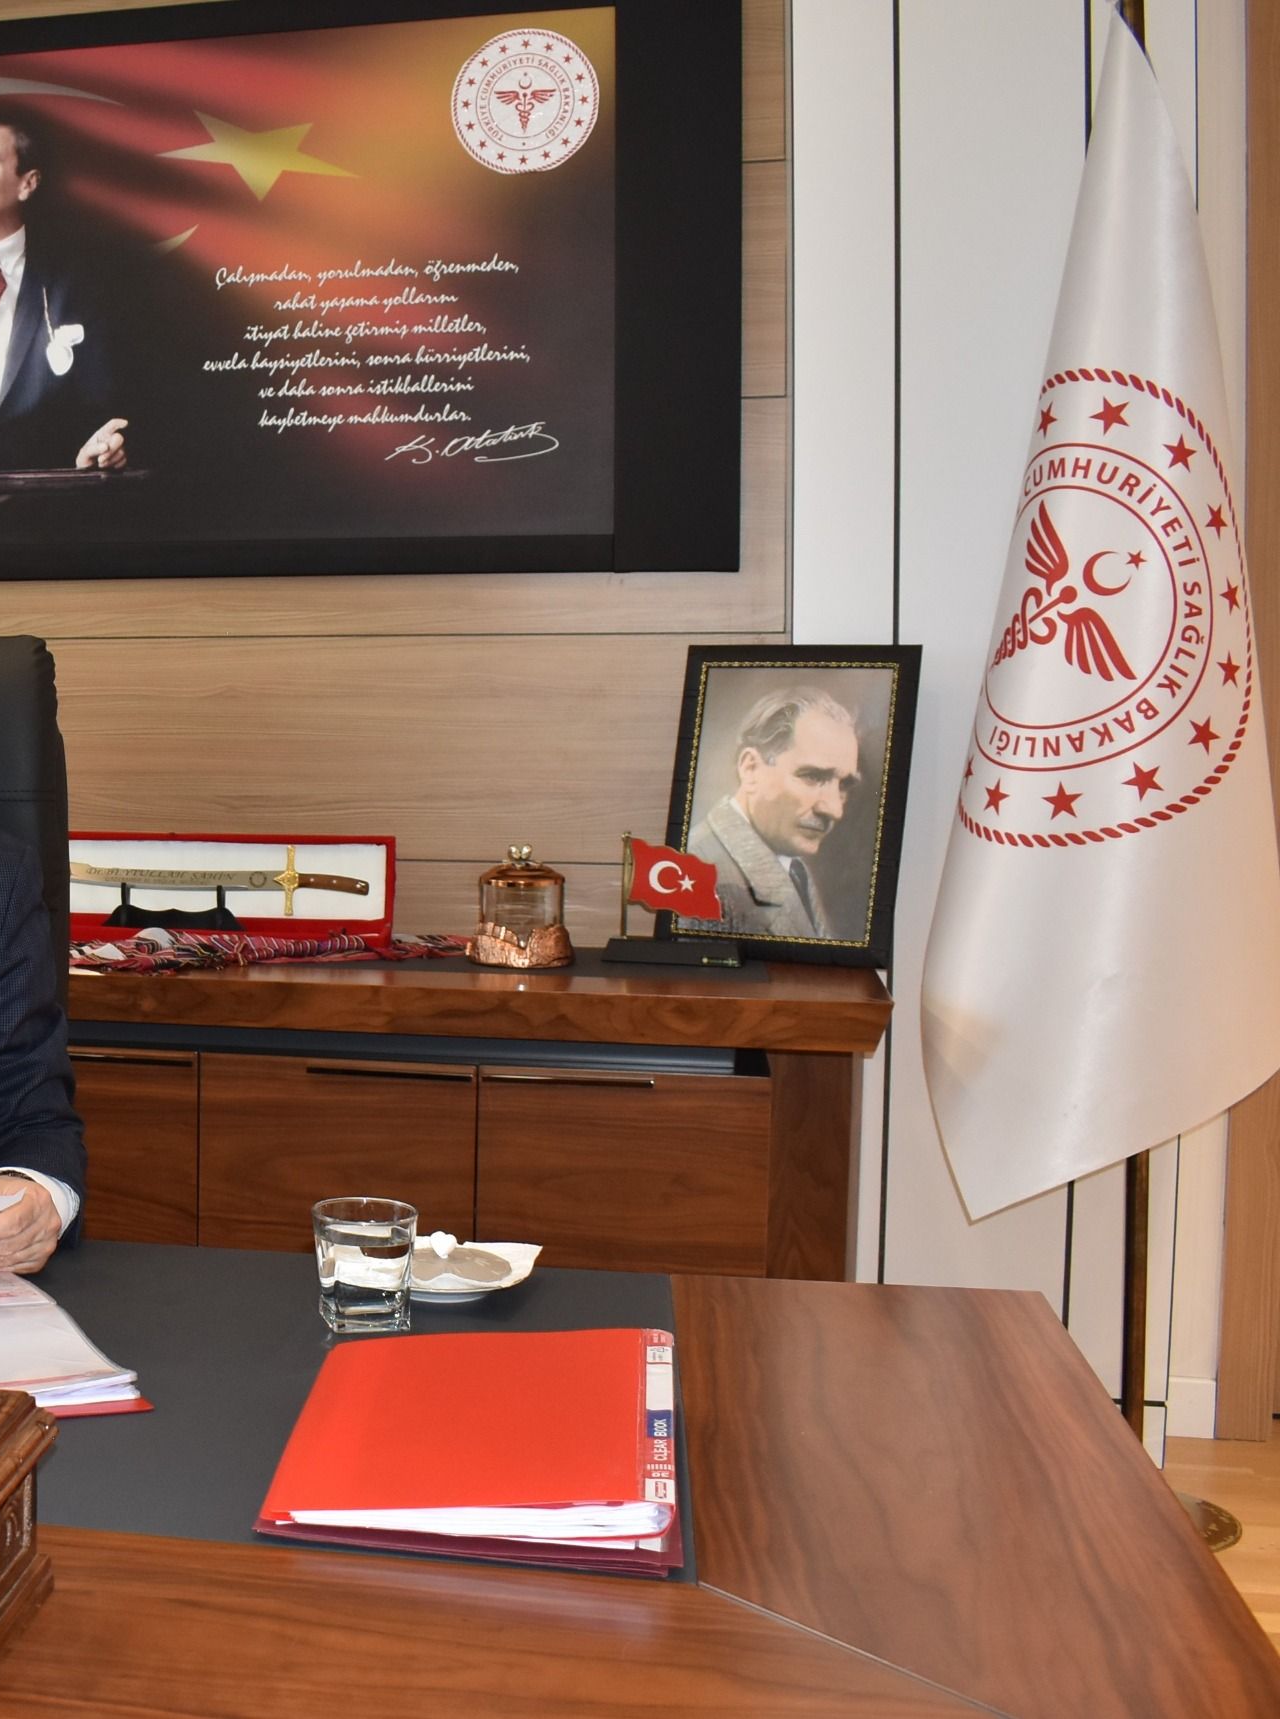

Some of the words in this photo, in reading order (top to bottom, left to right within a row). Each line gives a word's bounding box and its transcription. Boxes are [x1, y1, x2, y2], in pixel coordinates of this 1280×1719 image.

[215, 264, 311, 289] Çalışmadan,
[317, 259, 418, 288] yorulmadan,
[424, 253, 519, 281] öğrenmeden,
[274, 291, 317, 311] rahat
[320, 294, 379, 315] yaşama
[384, 287, 458, 313] yollarını
[244, 321, 291, 348] itiyat
[292, 318, 341, 339] haline
[344, 319, 409, 344] getirmiş
[412, 314, 487, 336] milletler,
[202, 352, 248, 372] evvela
[365, 350, 412, 367] sonra
[259, 386, 275, 398] ve
[278, 379, 316, 397] daha
[318, 381, 365, 396] sonra
[367, 375, 474, 396] istikballerini
[258, 407, 344, 433] kaybetmeye
[1023, 456, 1200, 569] CUMHURİYETİ
[1157, 581, 1205, 698] SAĞLIK
[989, 696, 1160, 758] BAKANLIĞI
[653, 1419, 668, 1437] BOOK
[653, 1439, 668, 1461] CLEAR
